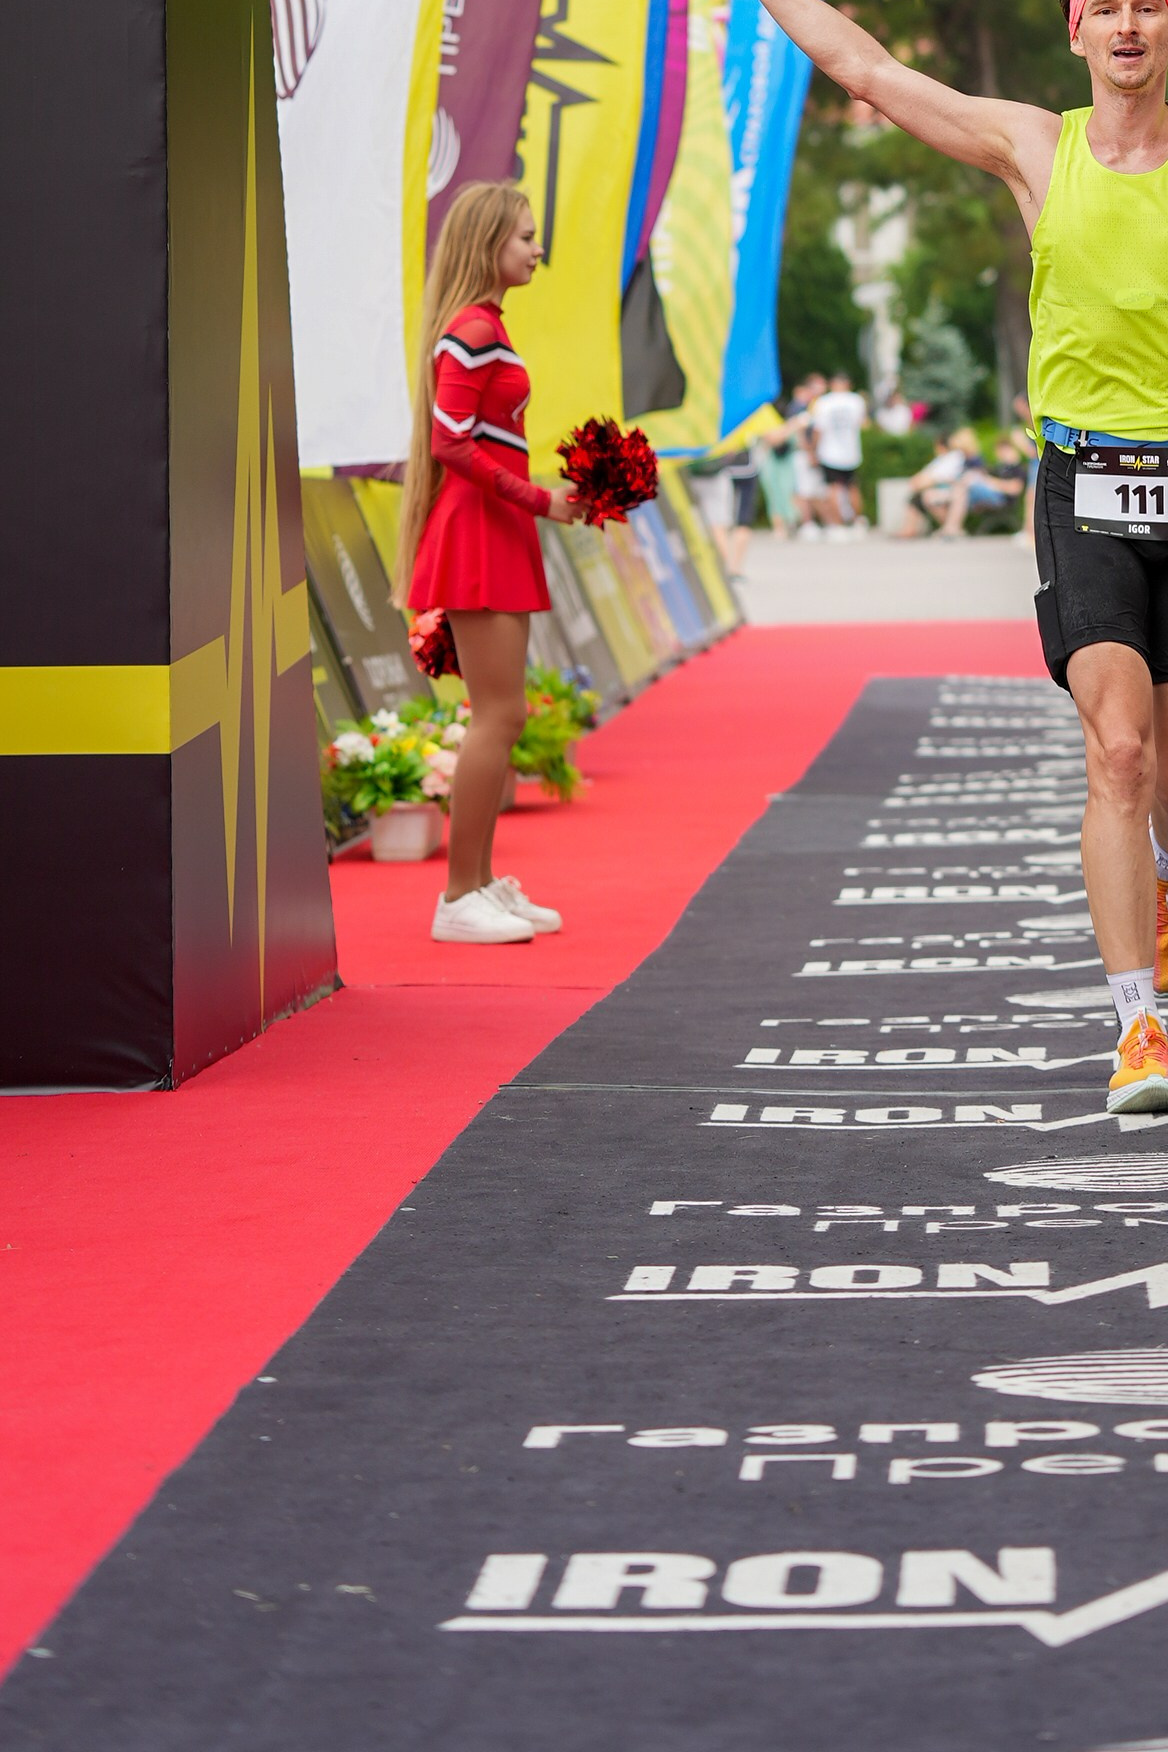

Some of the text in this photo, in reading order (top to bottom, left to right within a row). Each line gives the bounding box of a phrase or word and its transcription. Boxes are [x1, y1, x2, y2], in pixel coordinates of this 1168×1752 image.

[1119, 454, 1160, 465] IRON STAR
[1114, 483, 1165, 515] 111
[1128, 524, 1151, 535] IGOR
[801, 955, 1055, 973] IRON
[744, 1046, 1047, 1065] IRON
[708, 1103, 1043, 1124] IRON
[622, 1261, 1051, 1291] IRON
[464, 1546, 1058, 1610] IRON
